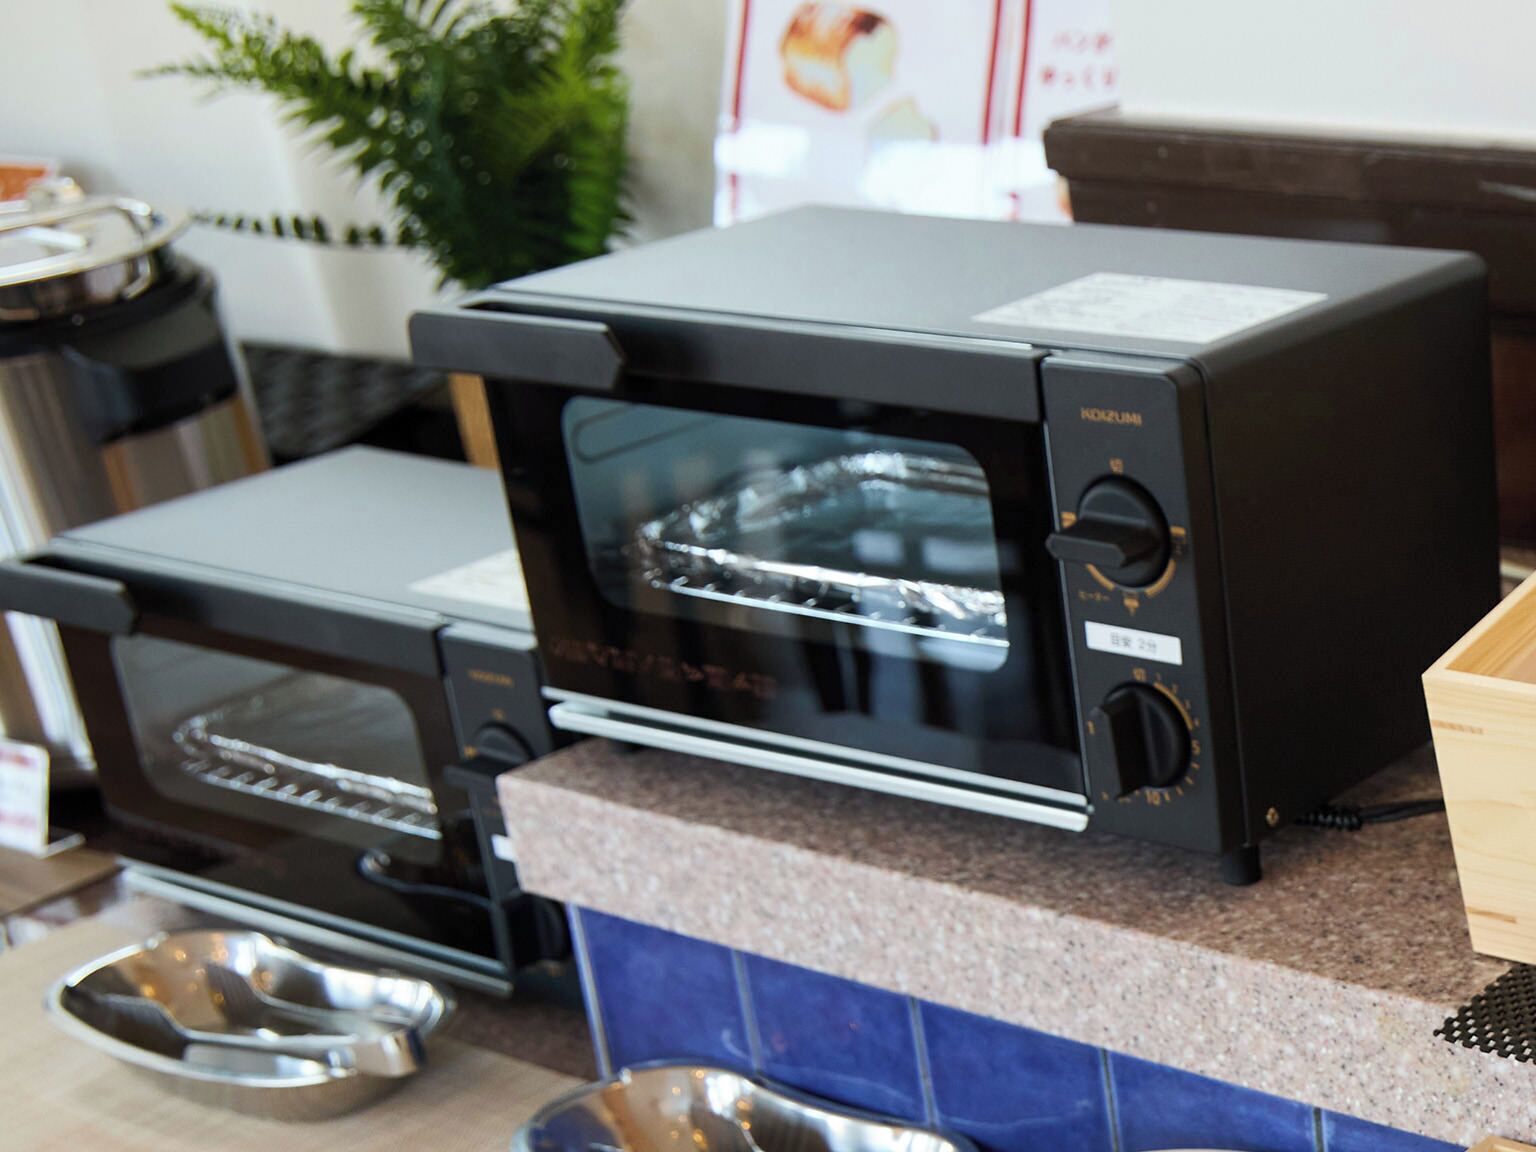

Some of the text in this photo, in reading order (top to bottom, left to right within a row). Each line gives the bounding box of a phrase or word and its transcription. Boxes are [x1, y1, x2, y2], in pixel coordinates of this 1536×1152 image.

[1080, 407, 1142, 427] KOIZUMI
[1191, 740, 1201, 754] 5
[1145, 789, 1161, 806] 10
